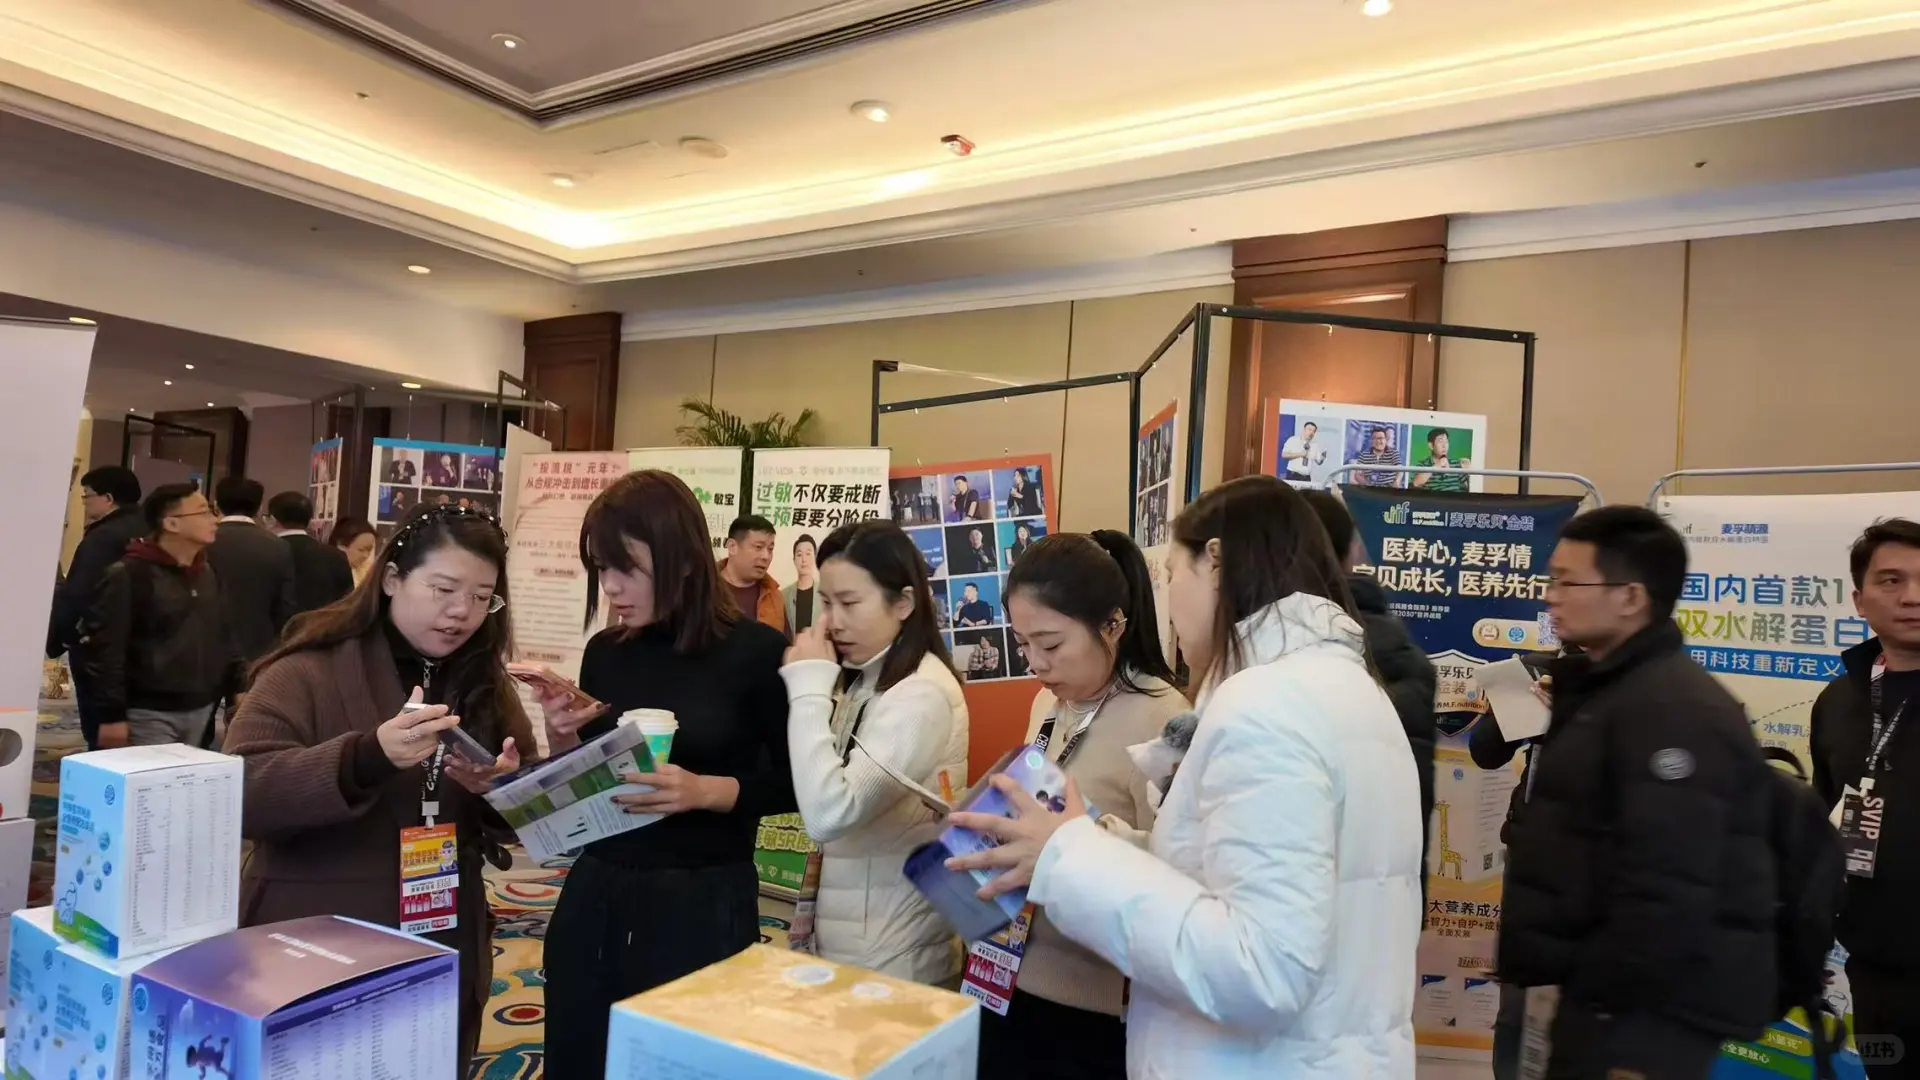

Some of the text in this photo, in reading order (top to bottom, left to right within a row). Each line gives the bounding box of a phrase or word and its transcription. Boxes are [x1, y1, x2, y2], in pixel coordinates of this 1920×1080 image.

[757, 482, 882, 505] 过敏不仅要戒断
[1676, 608, 1869, 648] 双水解蛋白
[1434, 665, 1475, 680] 孚乐贝
[1690, 649, 1842, 678] 用科技重新定义
[1859, 796, 1885, 841] SVIP
